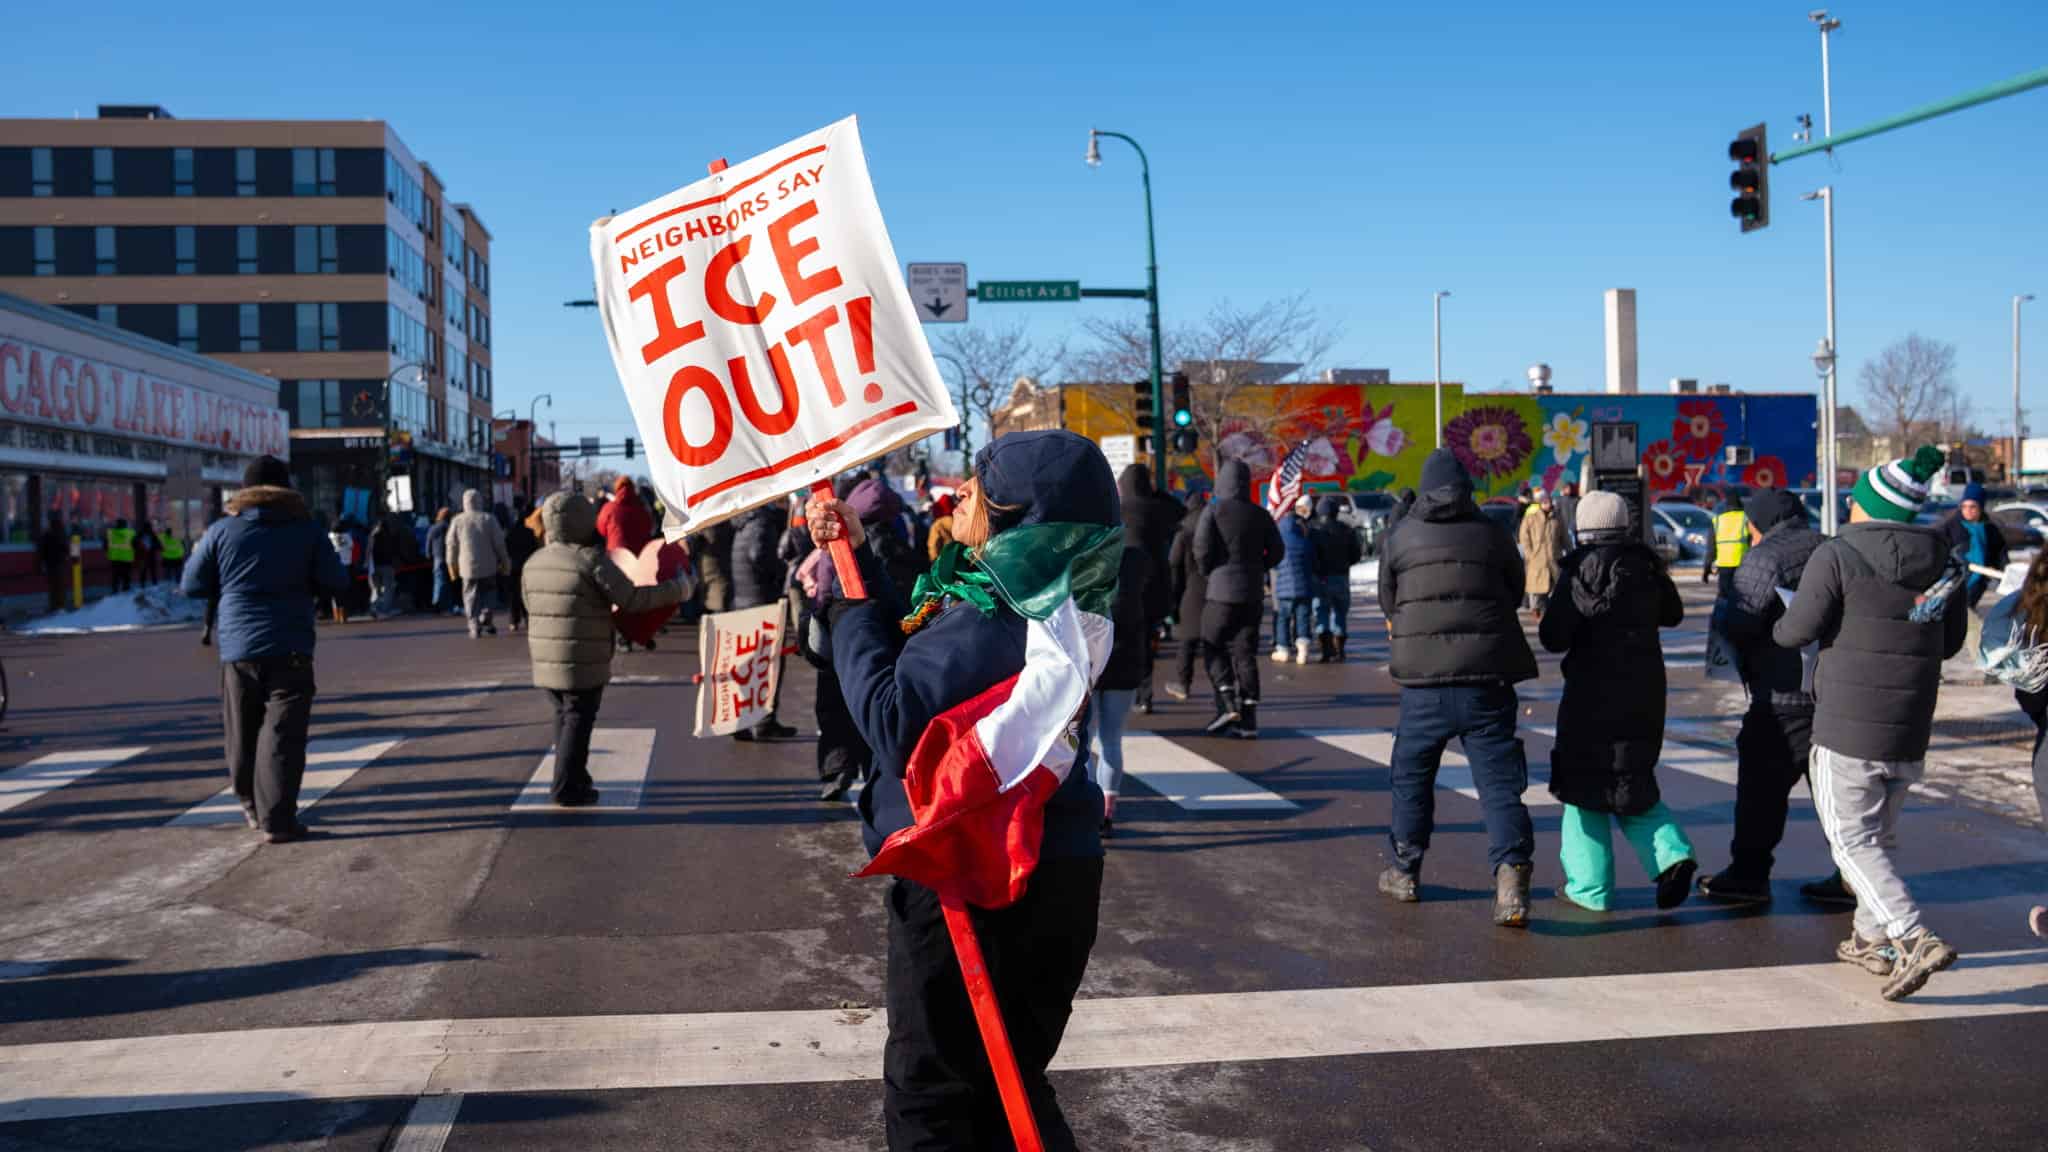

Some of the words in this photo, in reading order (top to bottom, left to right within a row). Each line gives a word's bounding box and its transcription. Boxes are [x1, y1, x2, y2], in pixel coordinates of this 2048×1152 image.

[620, 191, 769, 274] NEIGHBORS
[777, 164, 825, 200] SAY
[627, 198, 844, 366] ICE
[1038, 286, 1057, 297] Av
[662, 295, 884, 467] OUT!
[730, 629, 760, 718] ICE
